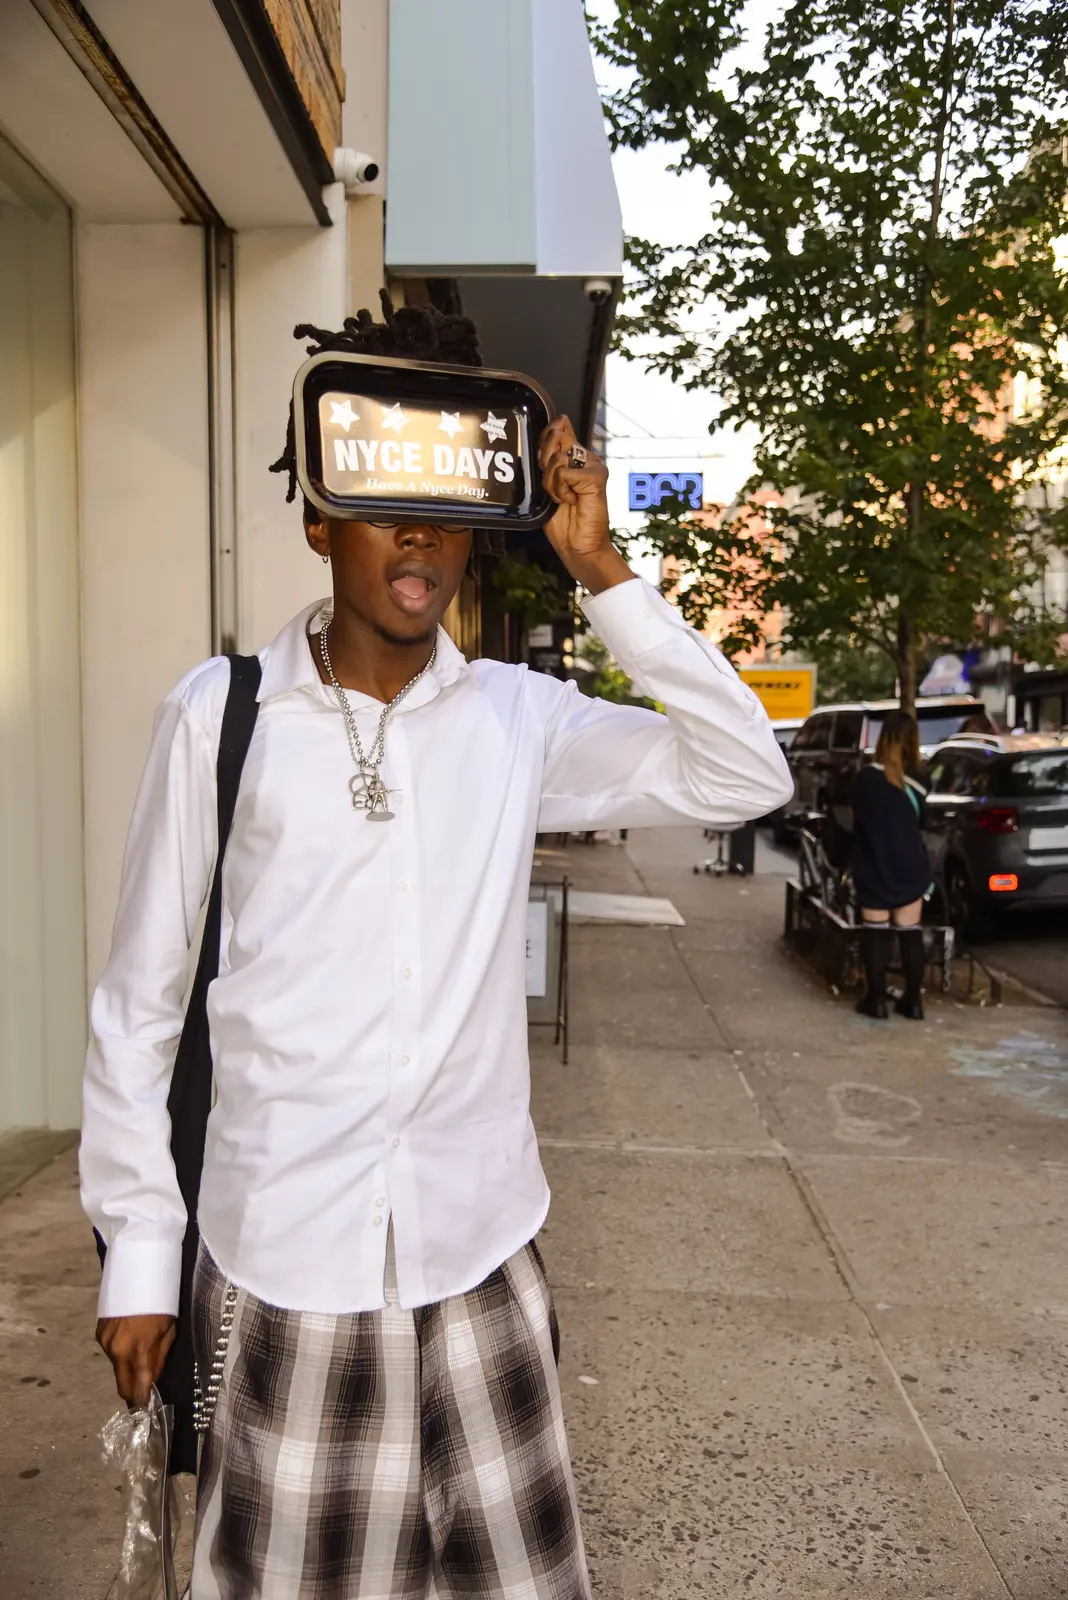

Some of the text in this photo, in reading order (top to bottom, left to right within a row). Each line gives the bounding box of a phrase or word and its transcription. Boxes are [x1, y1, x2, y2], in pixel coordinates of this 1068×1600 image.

[333, 438, 515, 484] NYCE DAYS
[366, 477, 490, 499] Have A Nyce Day.
